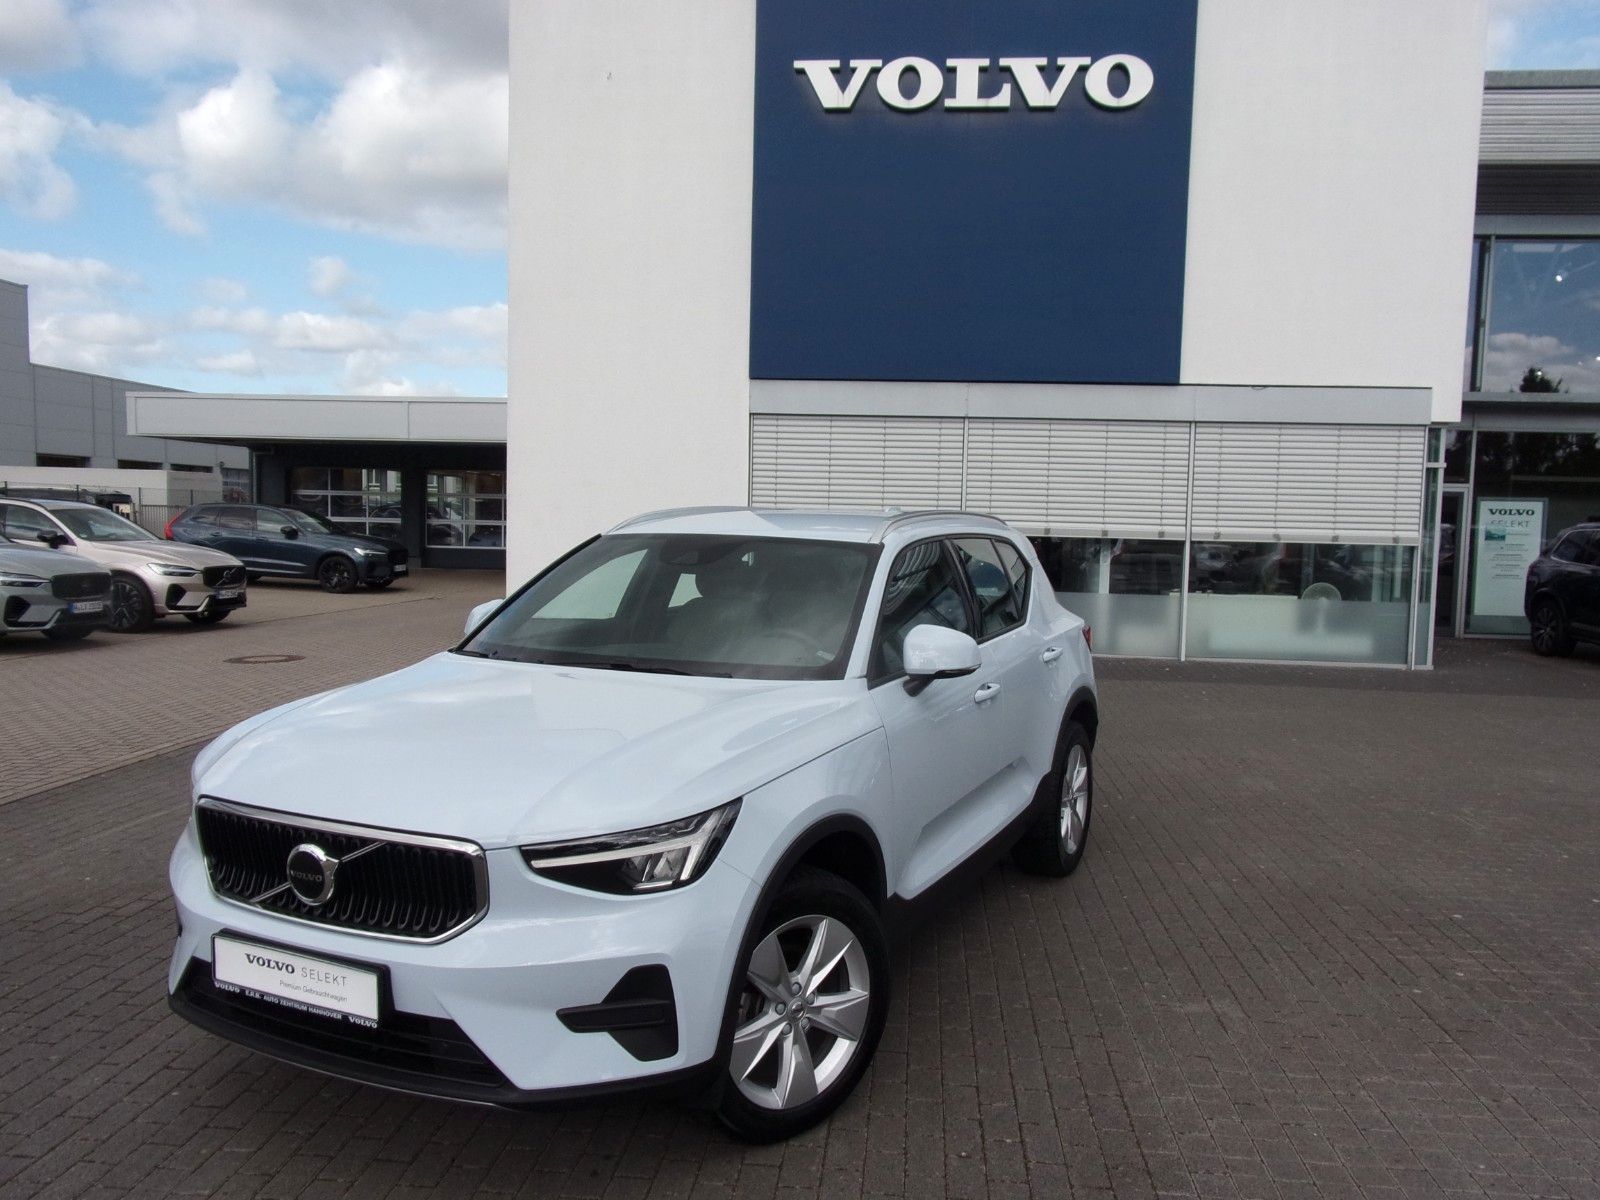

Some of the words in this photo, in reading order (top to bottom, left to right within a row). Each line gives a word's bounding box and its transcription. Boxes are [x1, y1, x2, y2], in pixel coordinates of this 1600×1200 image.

[793, 53, 1154, 110] VOLVO
[1488, 508, 1535, 516] VOLVO
[290, 869, 323, 882] VOLVO
[245, 953, 295, 975] VOLVO
[301, 967, 348, 987] SELEKT
[279, 980, 302, 991] Premium
[214, 981, 241, 994] VOLVO
[308, 1005, 343, 1020] HANNOVER
[348, 1015, 378, 1029] VOLVO
